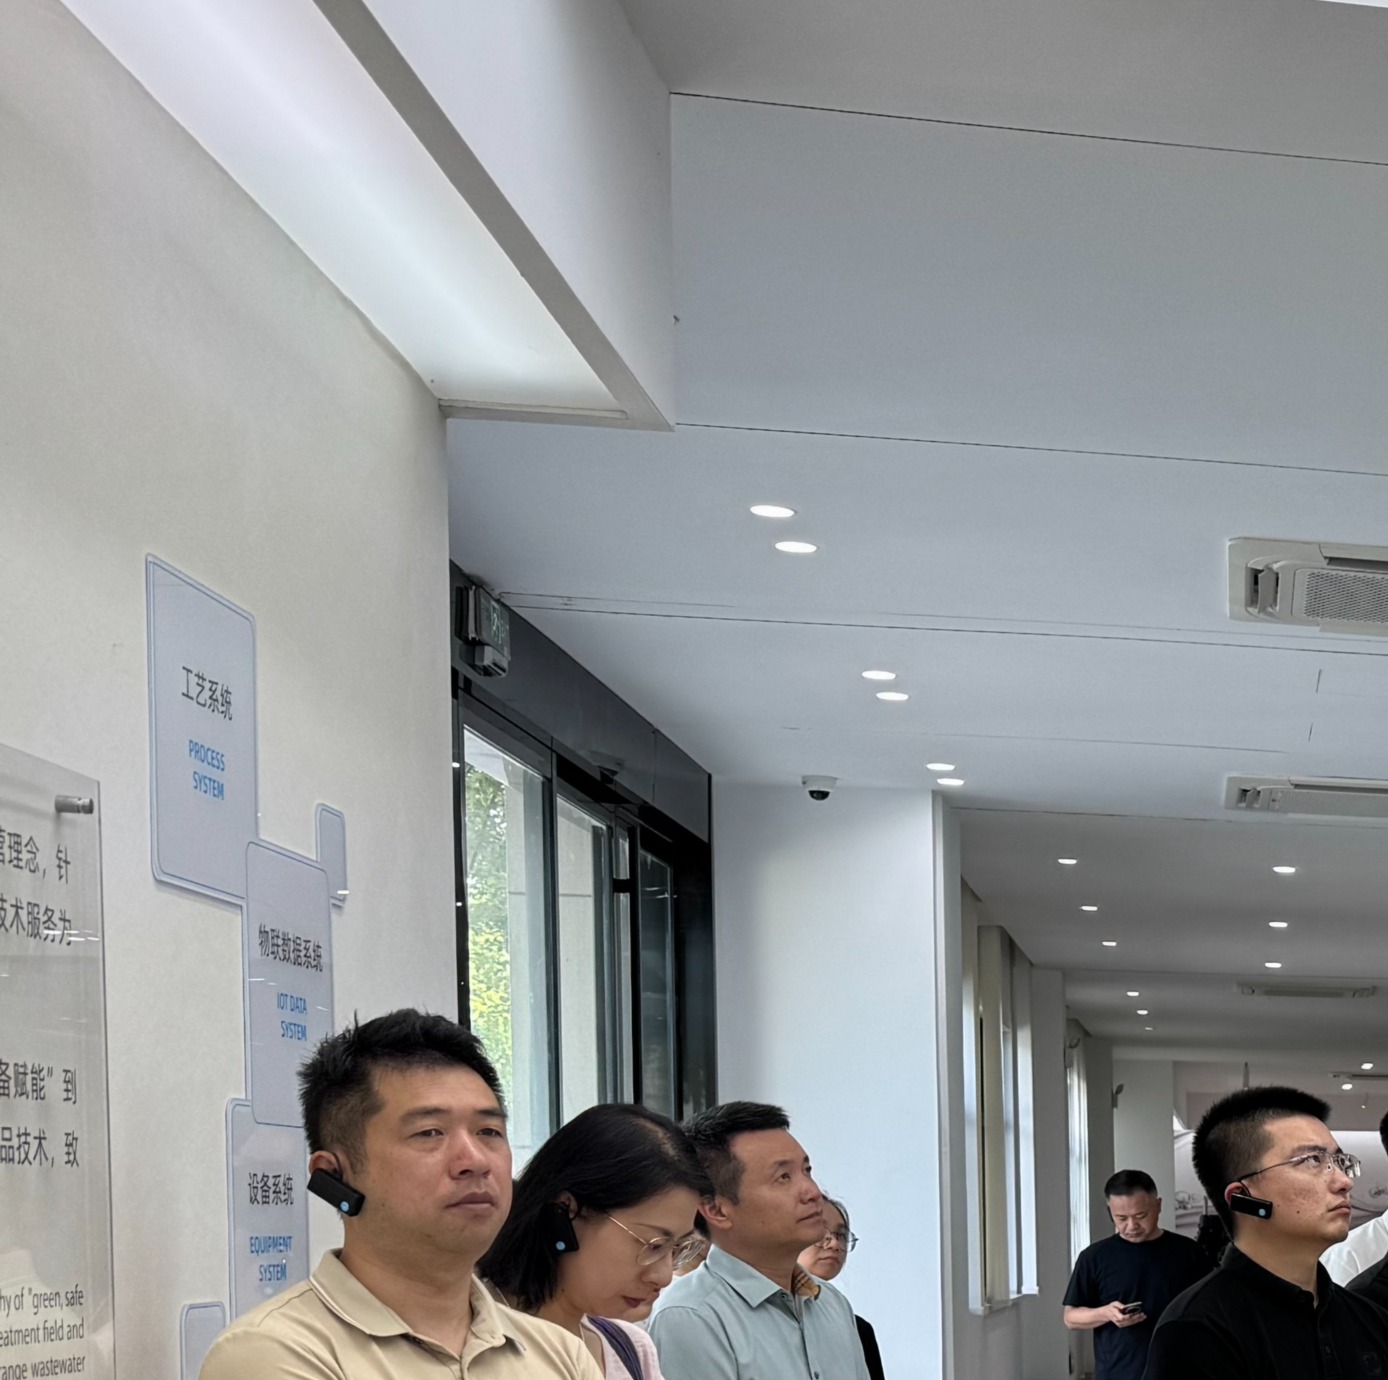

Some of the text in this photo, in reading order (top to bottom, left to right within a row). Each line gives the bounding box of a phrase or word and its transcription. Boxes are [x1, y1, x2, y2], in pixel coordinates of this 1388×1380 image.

[182, 666, 232, 721] 工艺系统
[188, 739, 225, 772] PROCESS
[193, 771, 224, 801] SYSTEM
[258, 923, 323, 972] 物联数据系统
[277, 991, 307, 1015] IOT DATA
[281, 1020, 307, 1041] SYSTEM
[248, 1172, 294, 1206] 设备系统
[250, 1236, 293, 1255] EQUIPMENT
[259, 1263, 287, 1283] SYSTEM
[14, 1287, 24, 1311] of
[65, 1284, 84, 1307] safe
[43, 1319, 64, 1343] field
[67, 1316, 84, 1340] and
[31, 1356, 85, 1378] wastewater
